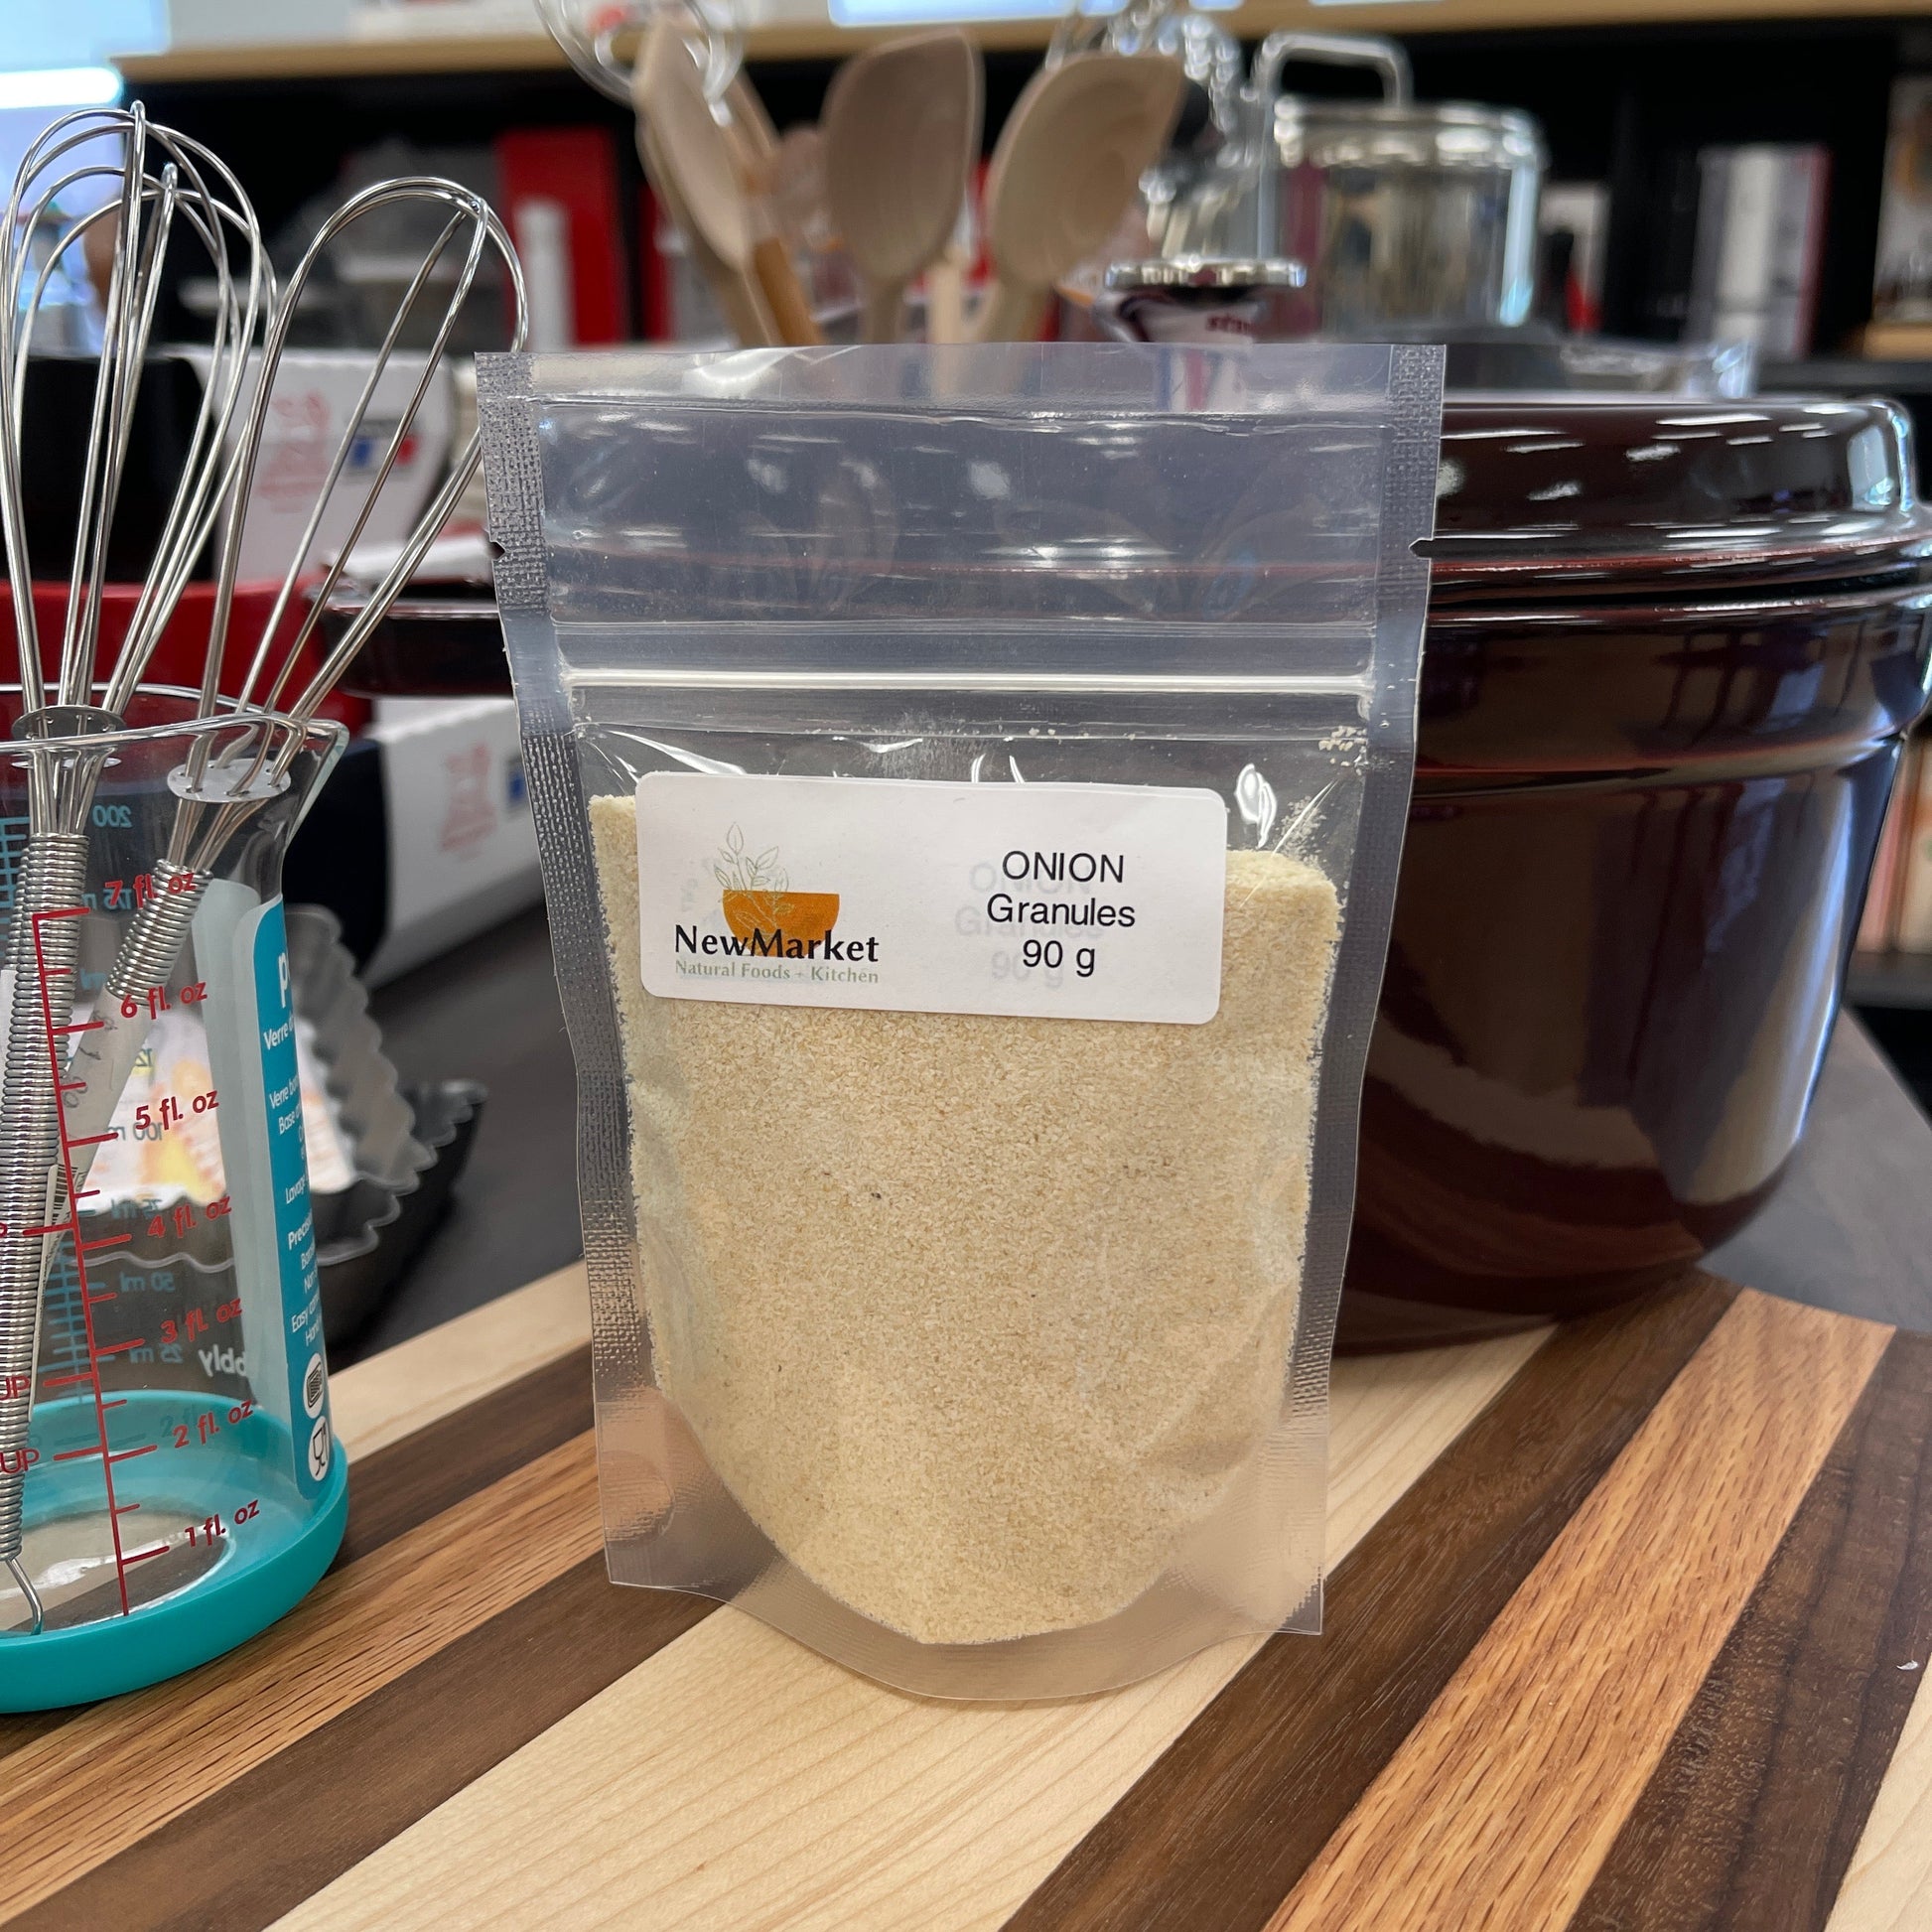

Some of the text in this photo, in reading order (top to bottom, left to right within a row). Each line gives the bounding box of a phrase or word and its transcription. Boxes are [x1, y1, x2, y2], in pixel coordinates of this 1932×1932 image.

[1002, 850, 1124, 883] ONION
[104, 880, 123, 906] 7
[168, 873, 197, 894] oz
[987, 894, 1136, 927] Granules
[675, 924, 880, 962] NewMarket
[1023, 939, 1095, 978] 90 g
[675, 959, 735, 977] Natural
[742, 963, 790, 980] Foods
[811, 966, 879, 983] Kitchen
[121, 982, 207, 1020] 6 fl. oz
[263, 1021, 289, 1050] Verre
[135, 1090, 219, 1131] 5 fl. oz
[147, 1196, 232, 1239] 4 fl. oz
[161, 1298, 242, 1343] 3 fl. oz
[291, 1310, 309, 1333] Easy
[173, 1425, 190, 1449] 2
[198, 1412, 220, 1445] fl.
[228, 1400, 254, 1424] oz
[185, 1499, 260, 1548] 1 fl. oz
